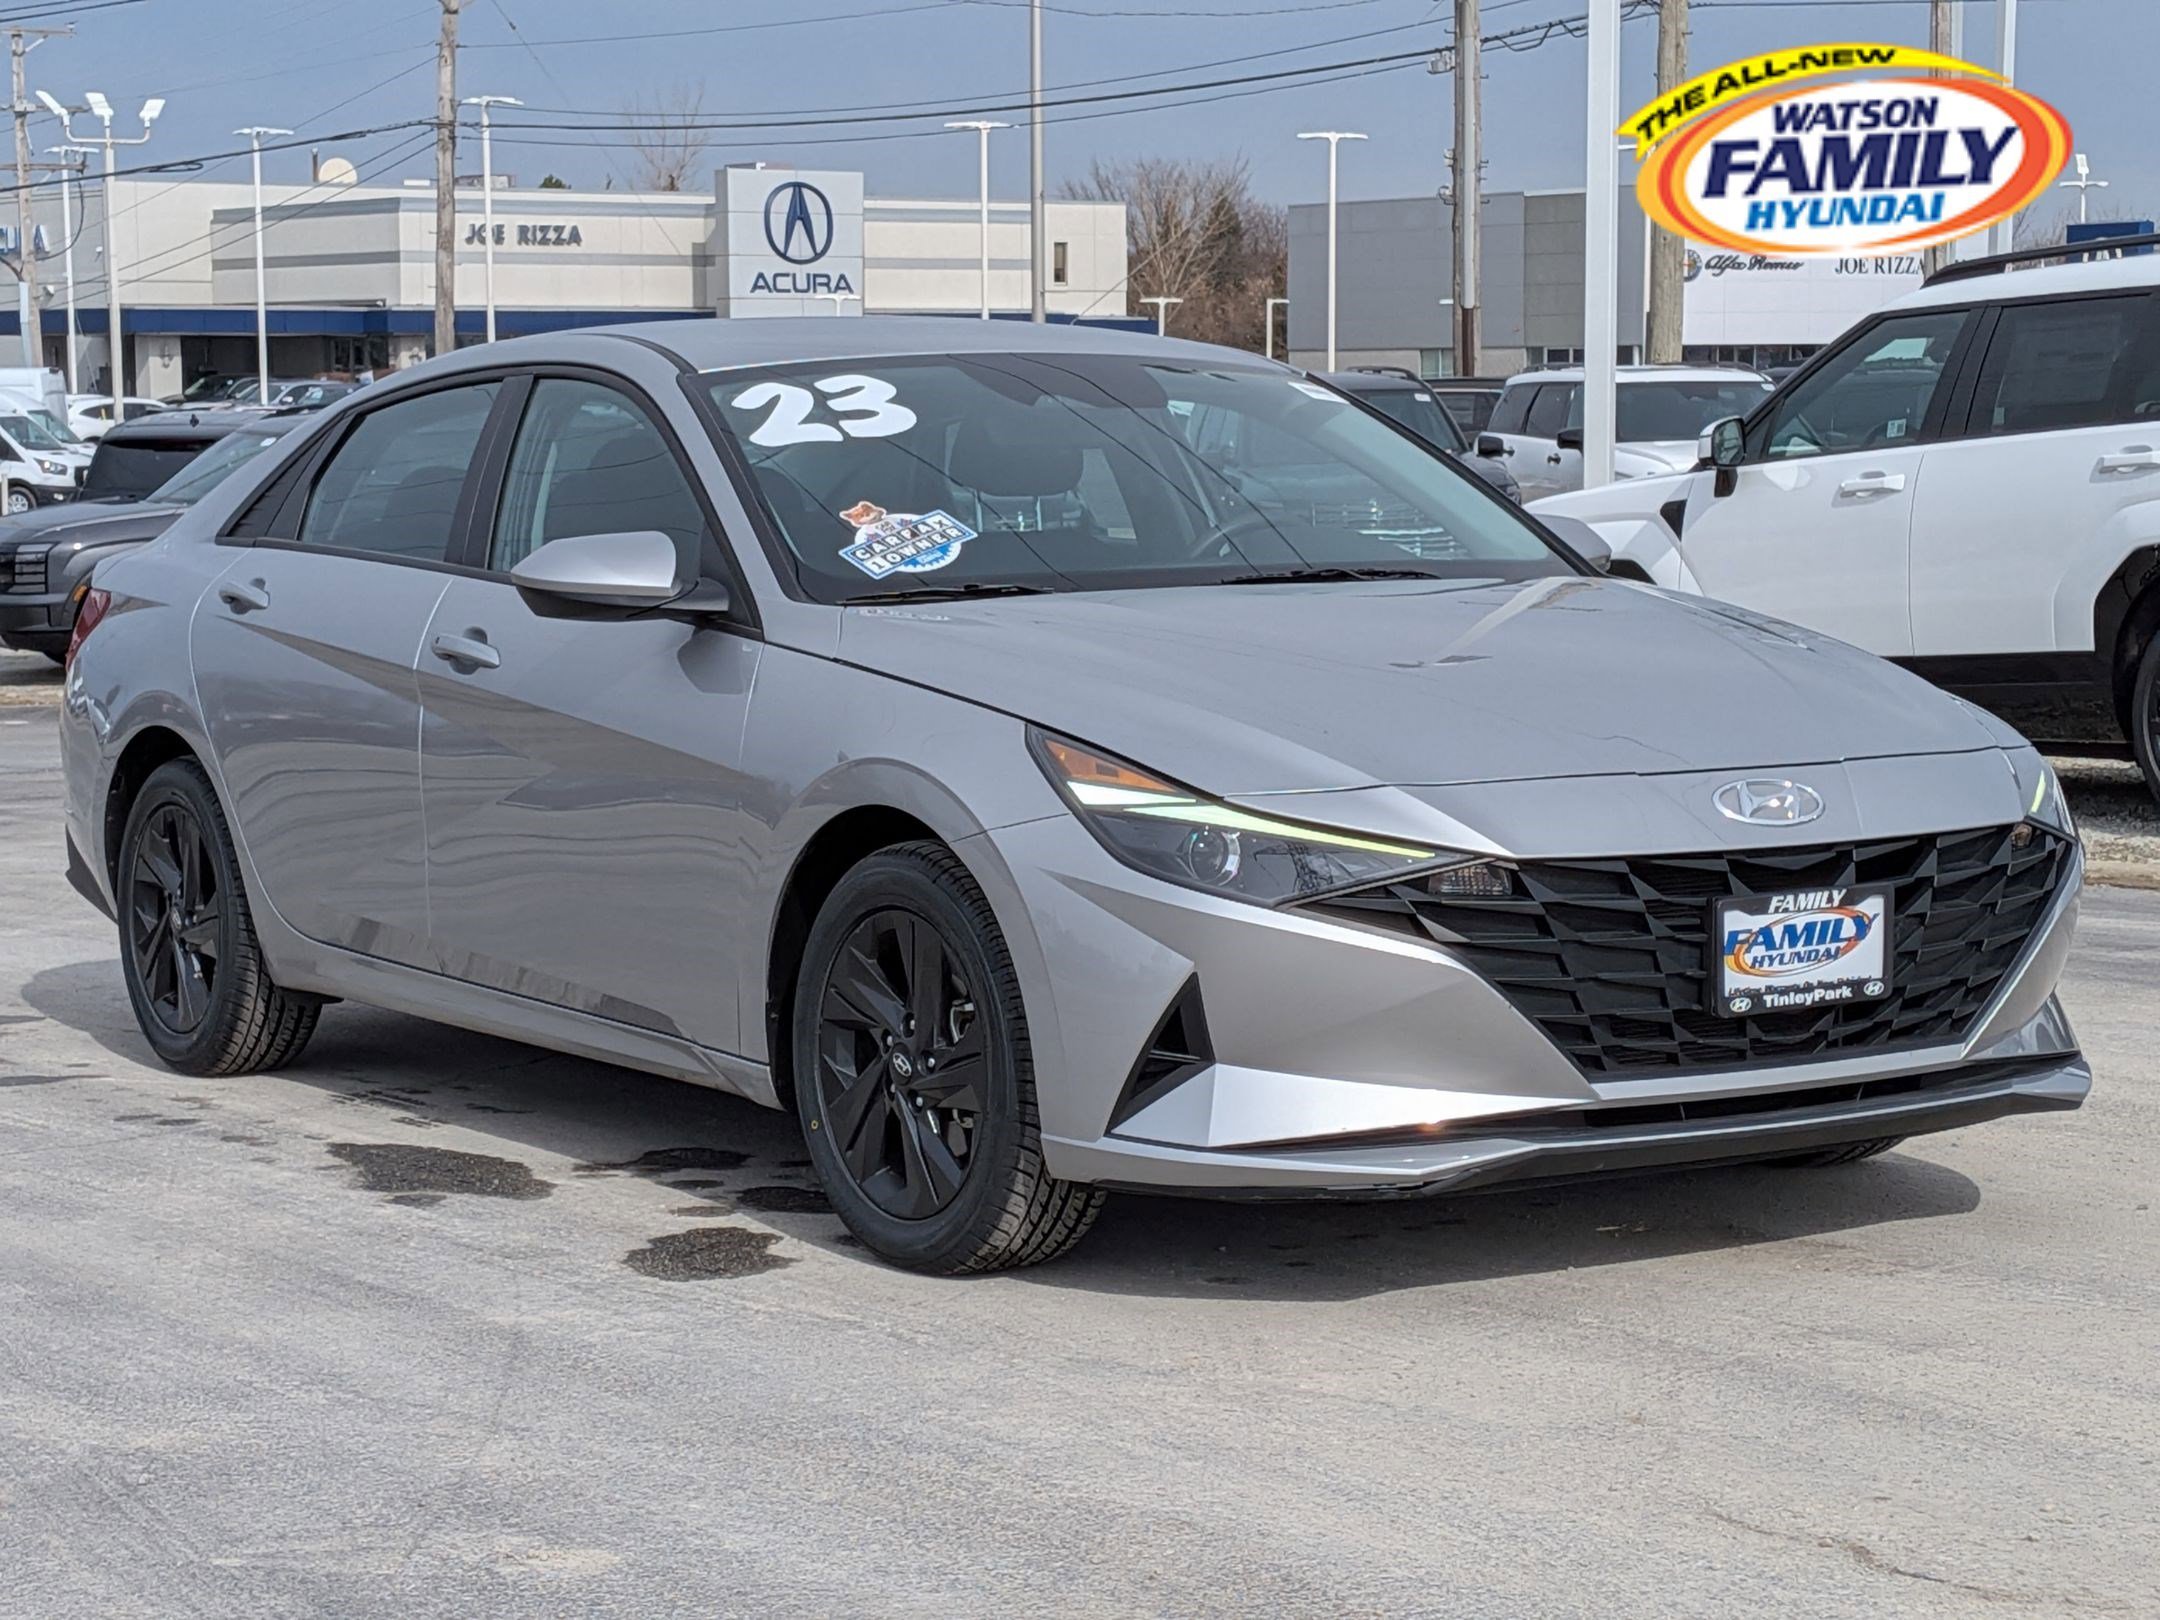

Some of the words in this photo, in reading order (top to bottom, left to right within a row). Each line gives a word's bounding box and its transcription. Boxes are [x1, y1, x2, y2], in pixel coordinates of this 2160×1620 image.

[465, 223, 505, 246] JOE
[517, 224, 583, 247] RIZZA
[1704, 255, 1747, 278] Alfa
[1835, 257, 1869, 275] JOE
[750, 272, 854, 294] ACURA
[731, 374, 917, 447] 23
[1768, 888, 1847, 914] FAMILY
[1724, 913, 1880, 956] FAMILY
[1749, 946, 1842, 969] HYUNDAI
